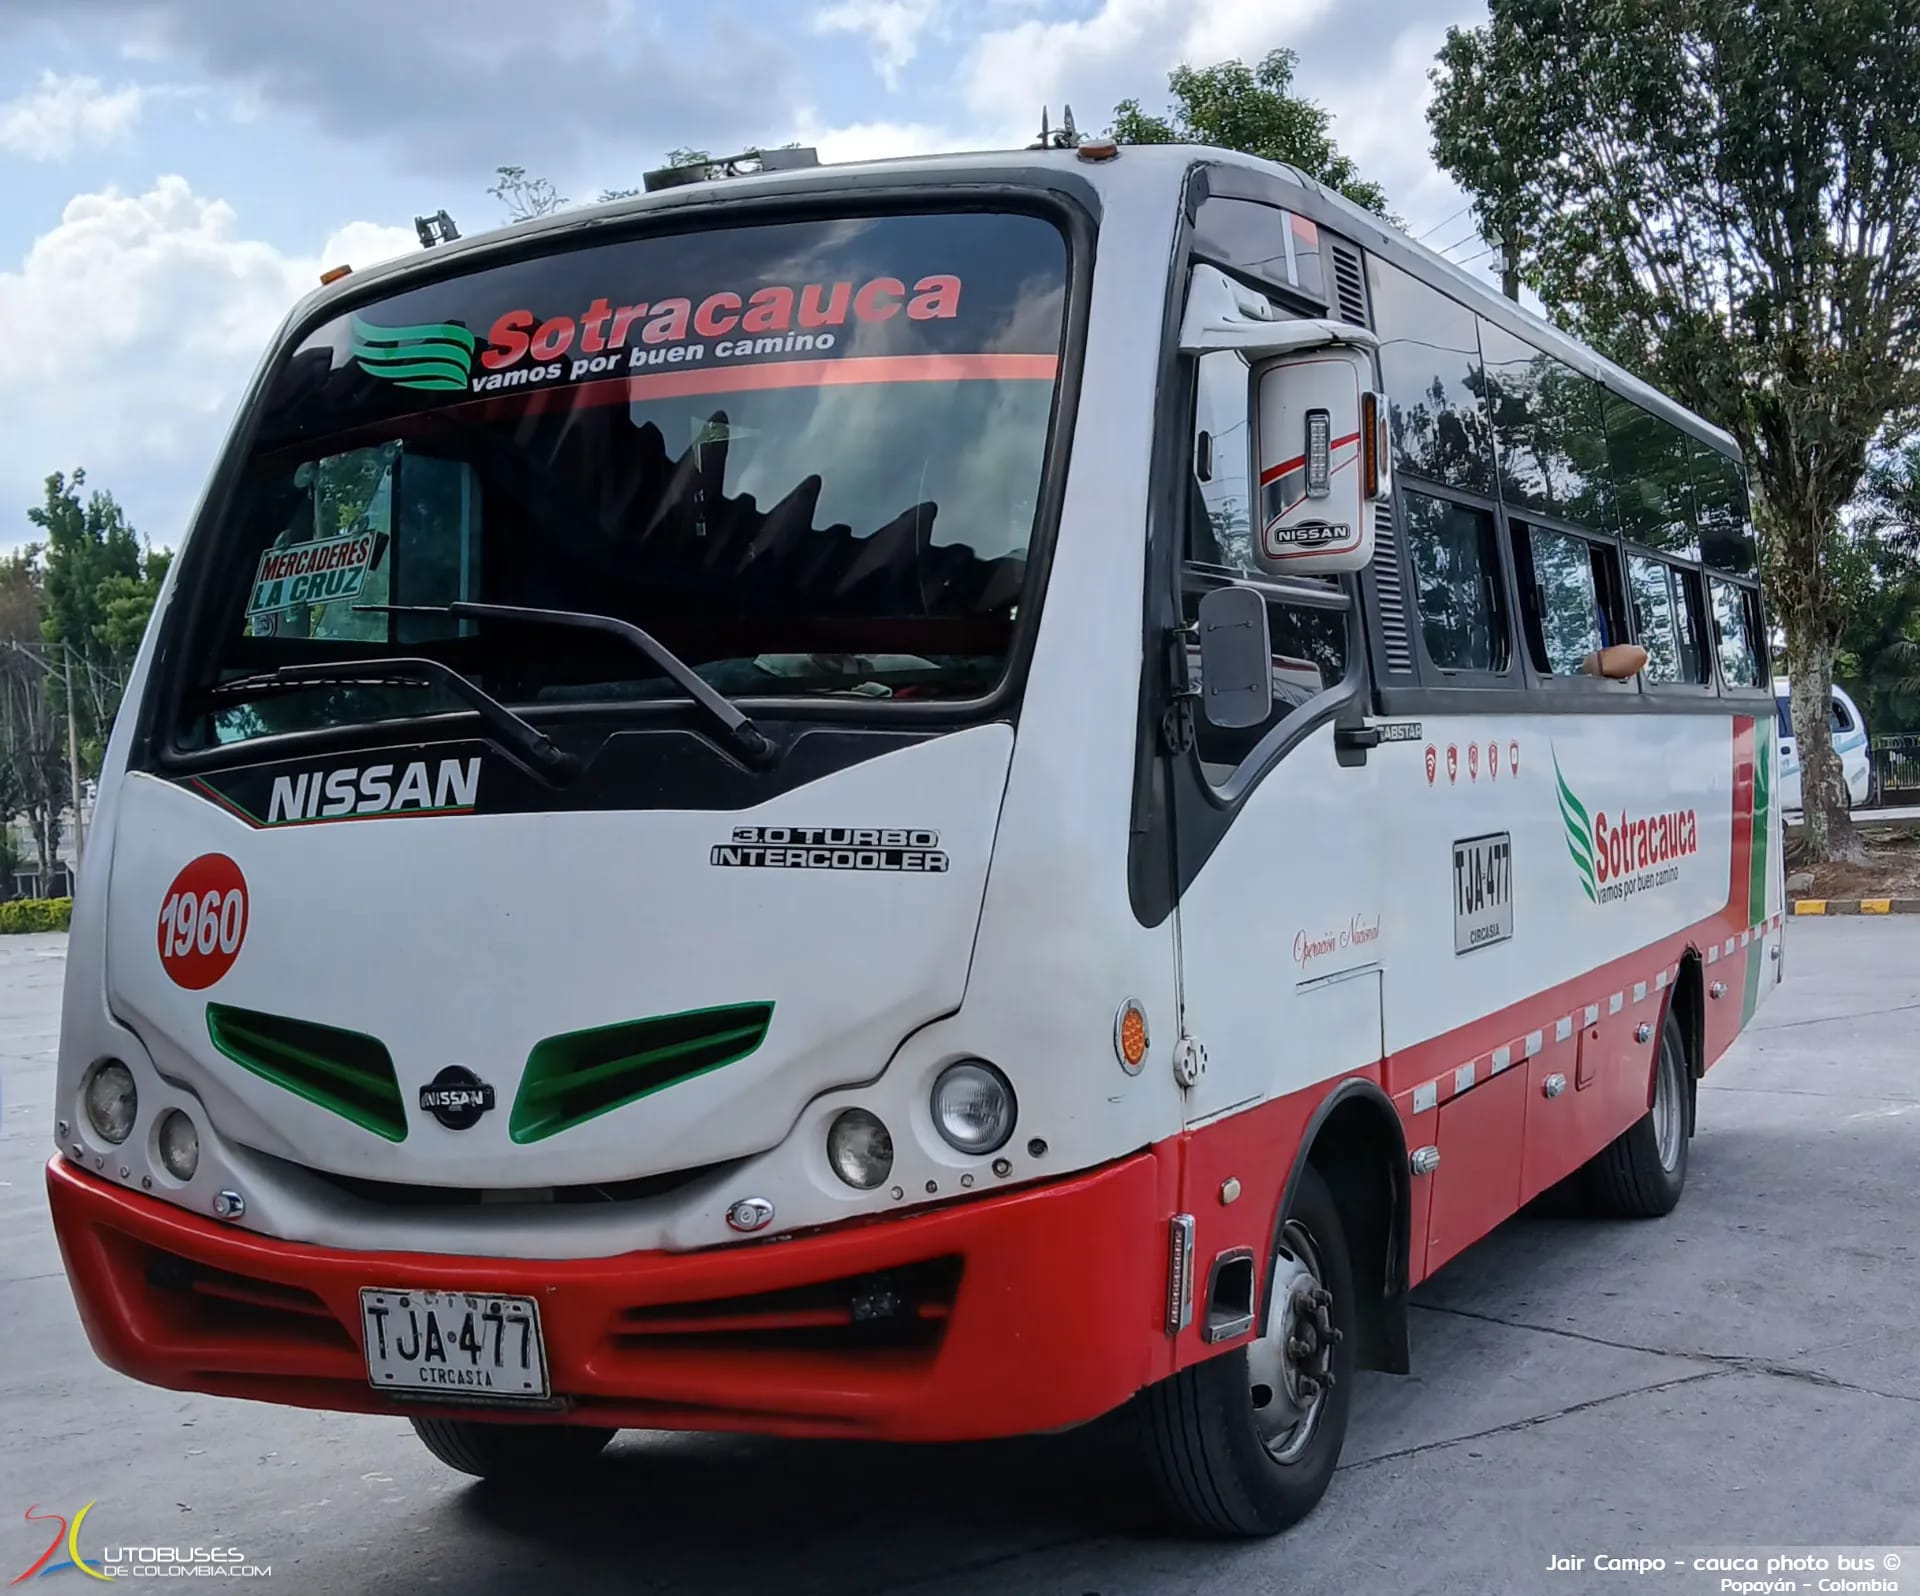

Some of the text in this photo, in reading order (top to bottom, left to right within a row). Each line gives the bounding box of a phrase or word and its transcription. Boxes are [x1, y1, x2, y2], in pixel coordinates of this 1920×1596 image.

[481, 274, 962, 369] Sotracauca
[472, 330, 836, 392] vamos por buen camino
[1277, 526, 1348, 542] NISSAN
[261, 537, 371, 582] MERCADERES
[253, 566, 361, 609] LA CRUZ
[267, 757, 482, 823] NISSAN
[797, 828, 938, 847] TURBO
[1595, 808, 1698, 883] Sotracauca
[711, 847, 948, 872] INTERCOOLER
[1596, 864, 1679, 905] vamos por buen camino
[161, 888, 244, 957] 1960
[1470, 923, 1500, 944] CIRCASIA
[424, 1090, 484, 1107] NISSAN
[419, 1366, 493, 1387] CIRCASIA
